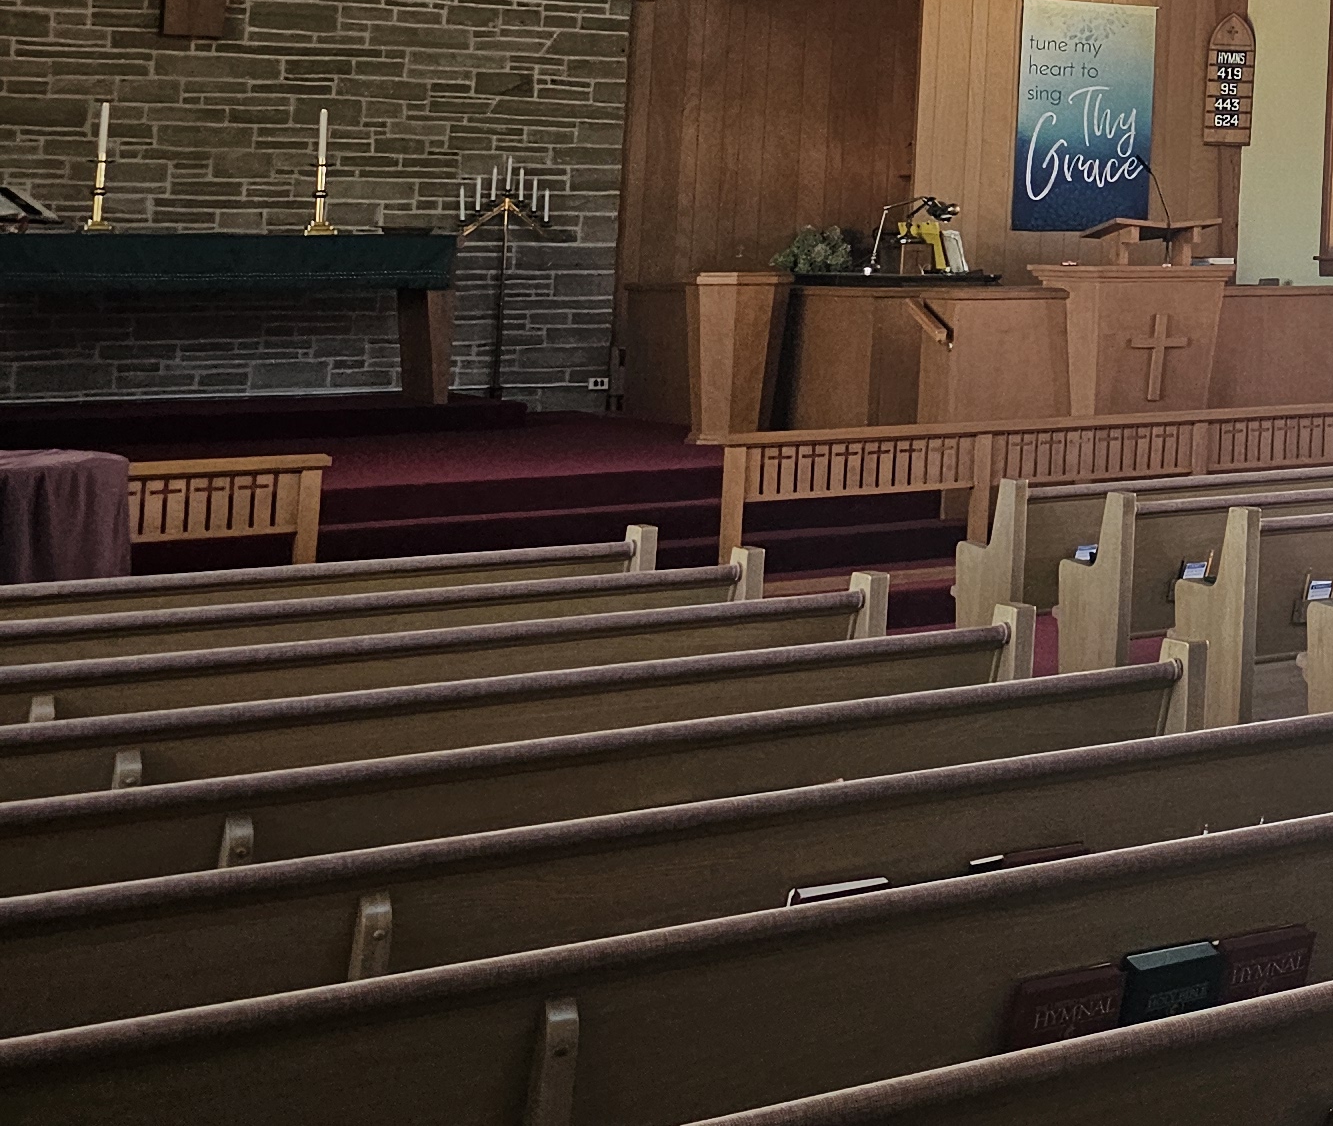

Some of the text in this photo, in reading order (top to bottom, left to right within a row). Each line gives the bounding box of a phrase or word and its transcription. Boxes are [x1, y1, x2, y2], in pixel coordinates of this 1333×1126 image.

[1029, 35, 1103, 59] tune my
[1217, 51, 1246, 65] HYMNS
[1028, 55, 1099, 79] heart to
[1216, 67, 1242, 80] 419
[1027, 85, 1062, 106] sing
[1220, 82, 1237, 95] 95
[1214, 98, 1240, 111] 443
[1068, 85, 1137, 157] Thy
[1214, 114, 1239, 127] 624
[1025, 111, 1145, 201] Grace
[1229, 954, 1306, 986] HYMNAL
[1033, 996, 1117, 1030] HYMNAL
